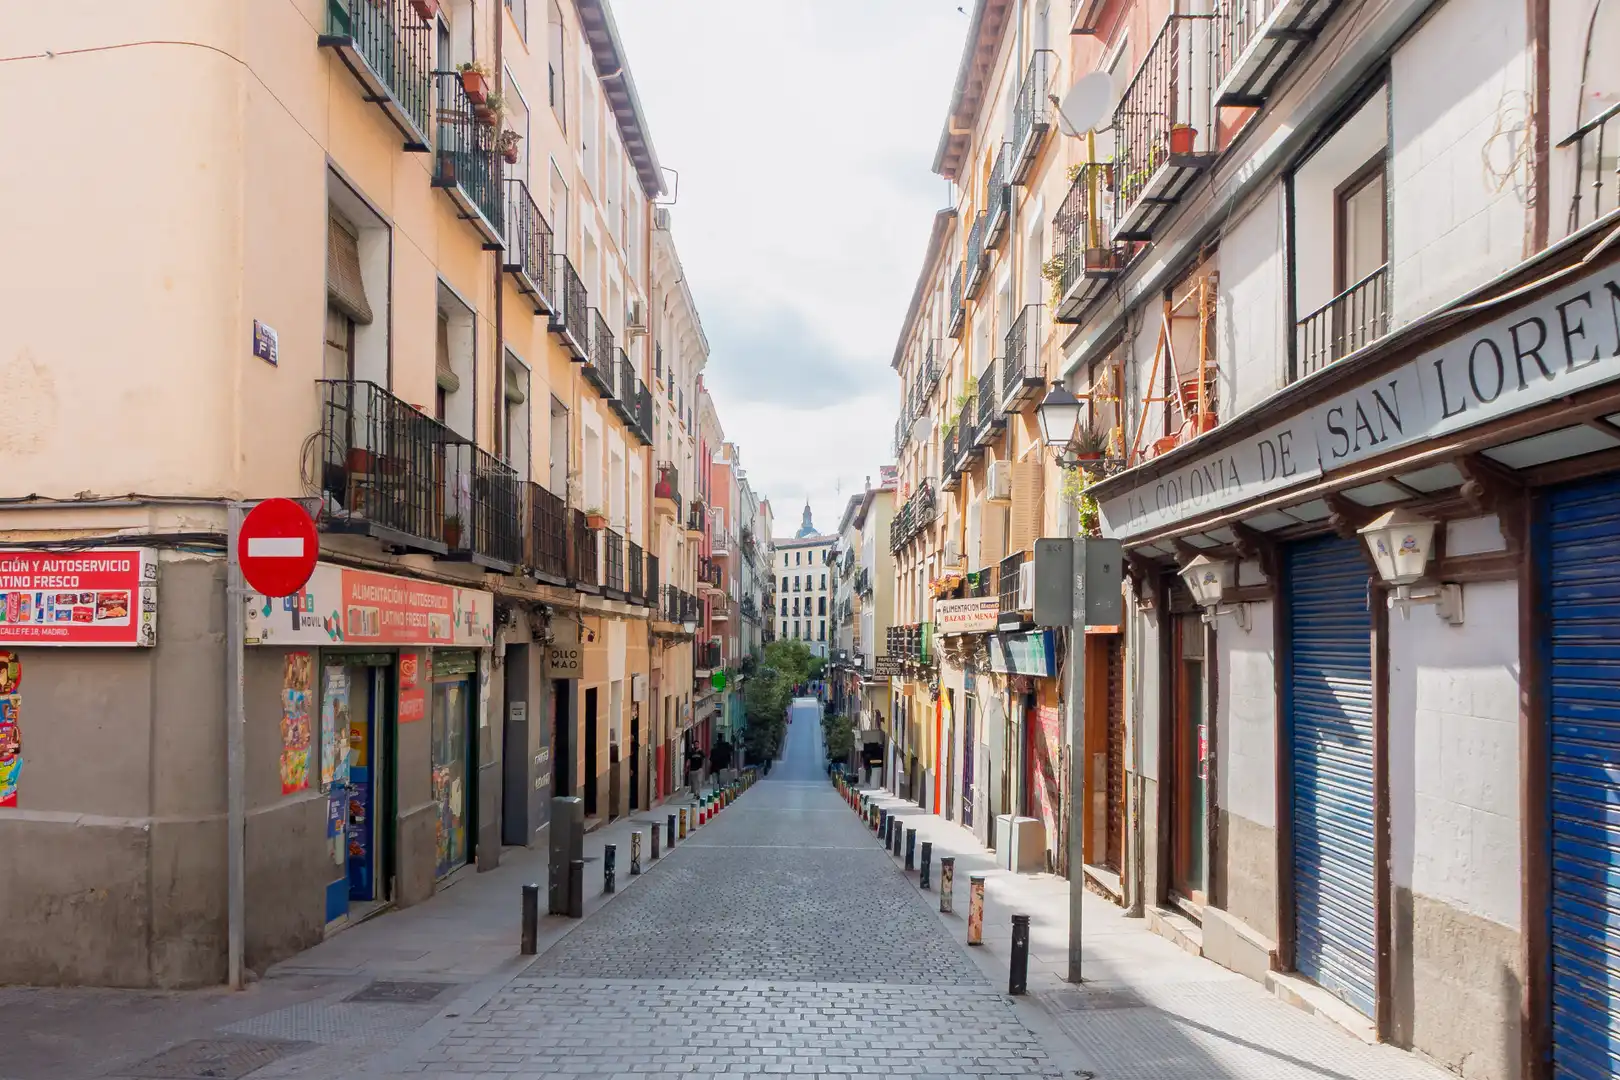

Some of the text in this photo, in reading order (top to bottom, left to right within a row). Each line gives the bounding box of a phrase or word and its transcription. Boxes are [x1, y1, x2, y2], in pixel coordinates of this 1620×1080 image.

[1126, 492, 1149, 529] LA
[1155, 456, 1245, 519] COLONIA
[1257, 430, 1297, 482] DE
[1326, 380, 1404, 458] SAN
[0, 556, 130, 572] CIÓN Y AUTOSERVICIO
[33, 576, 79, 588] FRESCO
[351, 583, 403, 605] ALIMENTACIÓN
[409, 591, 449, 609] AUTOSERVICIO
[381, 609, 427, 628] LATINO FRESCO
[0, 628, 20, 636] CALLE
[21, 628, 29, 636] FE
[41, 628, 70, 636] MADRID.
[551, 650, 577, 659] OLLO
[551, 660, 577, 669] MAO
